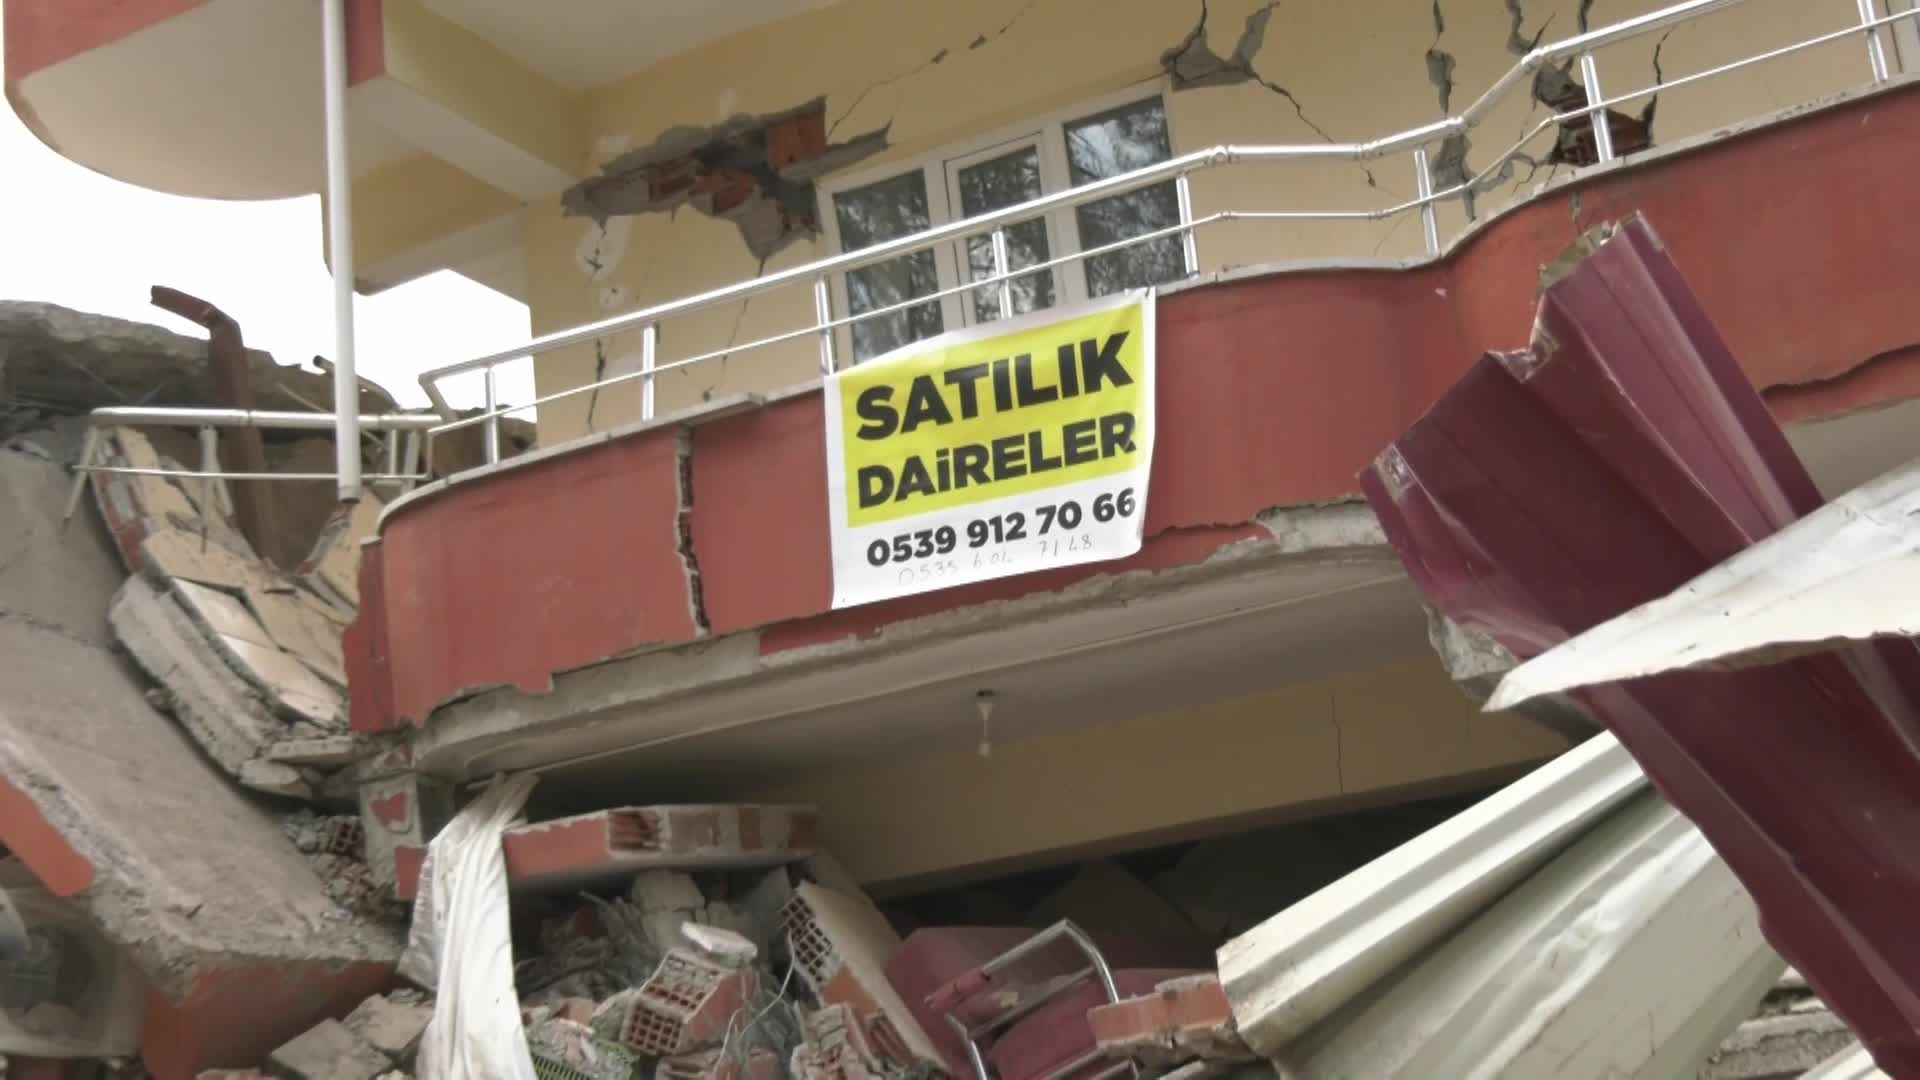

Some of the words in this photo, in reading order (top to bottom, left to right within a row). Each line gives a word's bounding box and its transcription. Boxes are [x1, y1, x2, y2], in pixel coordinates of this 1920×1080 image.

[856, 331, 1134, 441] SATILIK
[866, 525, 957, 567] 0539
[966, 512, 1027, 548] 912
[1035, 501, 1083, 535] 70
[1092, 487, 1136, 523] 66
